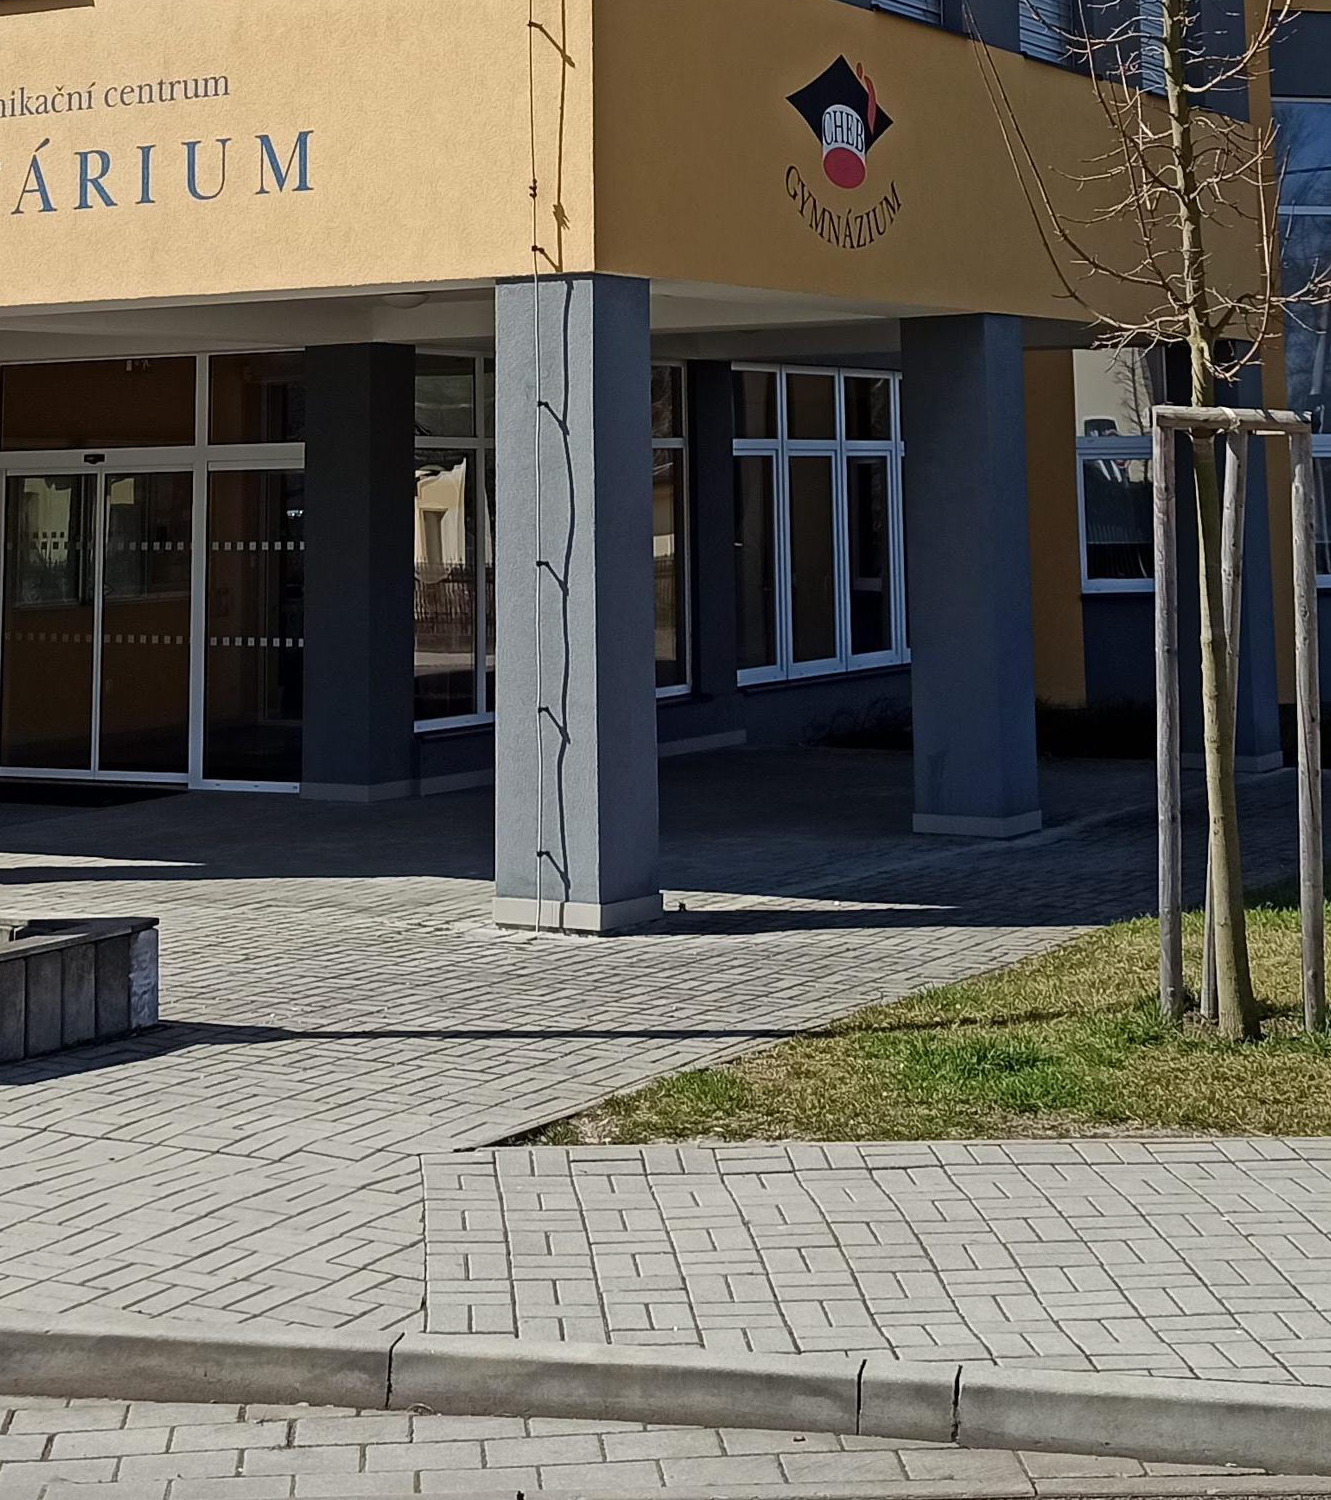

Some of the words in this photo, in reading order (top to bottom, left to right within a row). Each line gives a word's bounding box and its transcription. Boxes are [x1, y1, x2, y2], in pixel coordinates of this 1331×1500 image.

[104, 74, 230, 108] centrum
[823, 110, 865, 153] CHEB
[785, 165, 903, 249] GYMNÁZIUM
